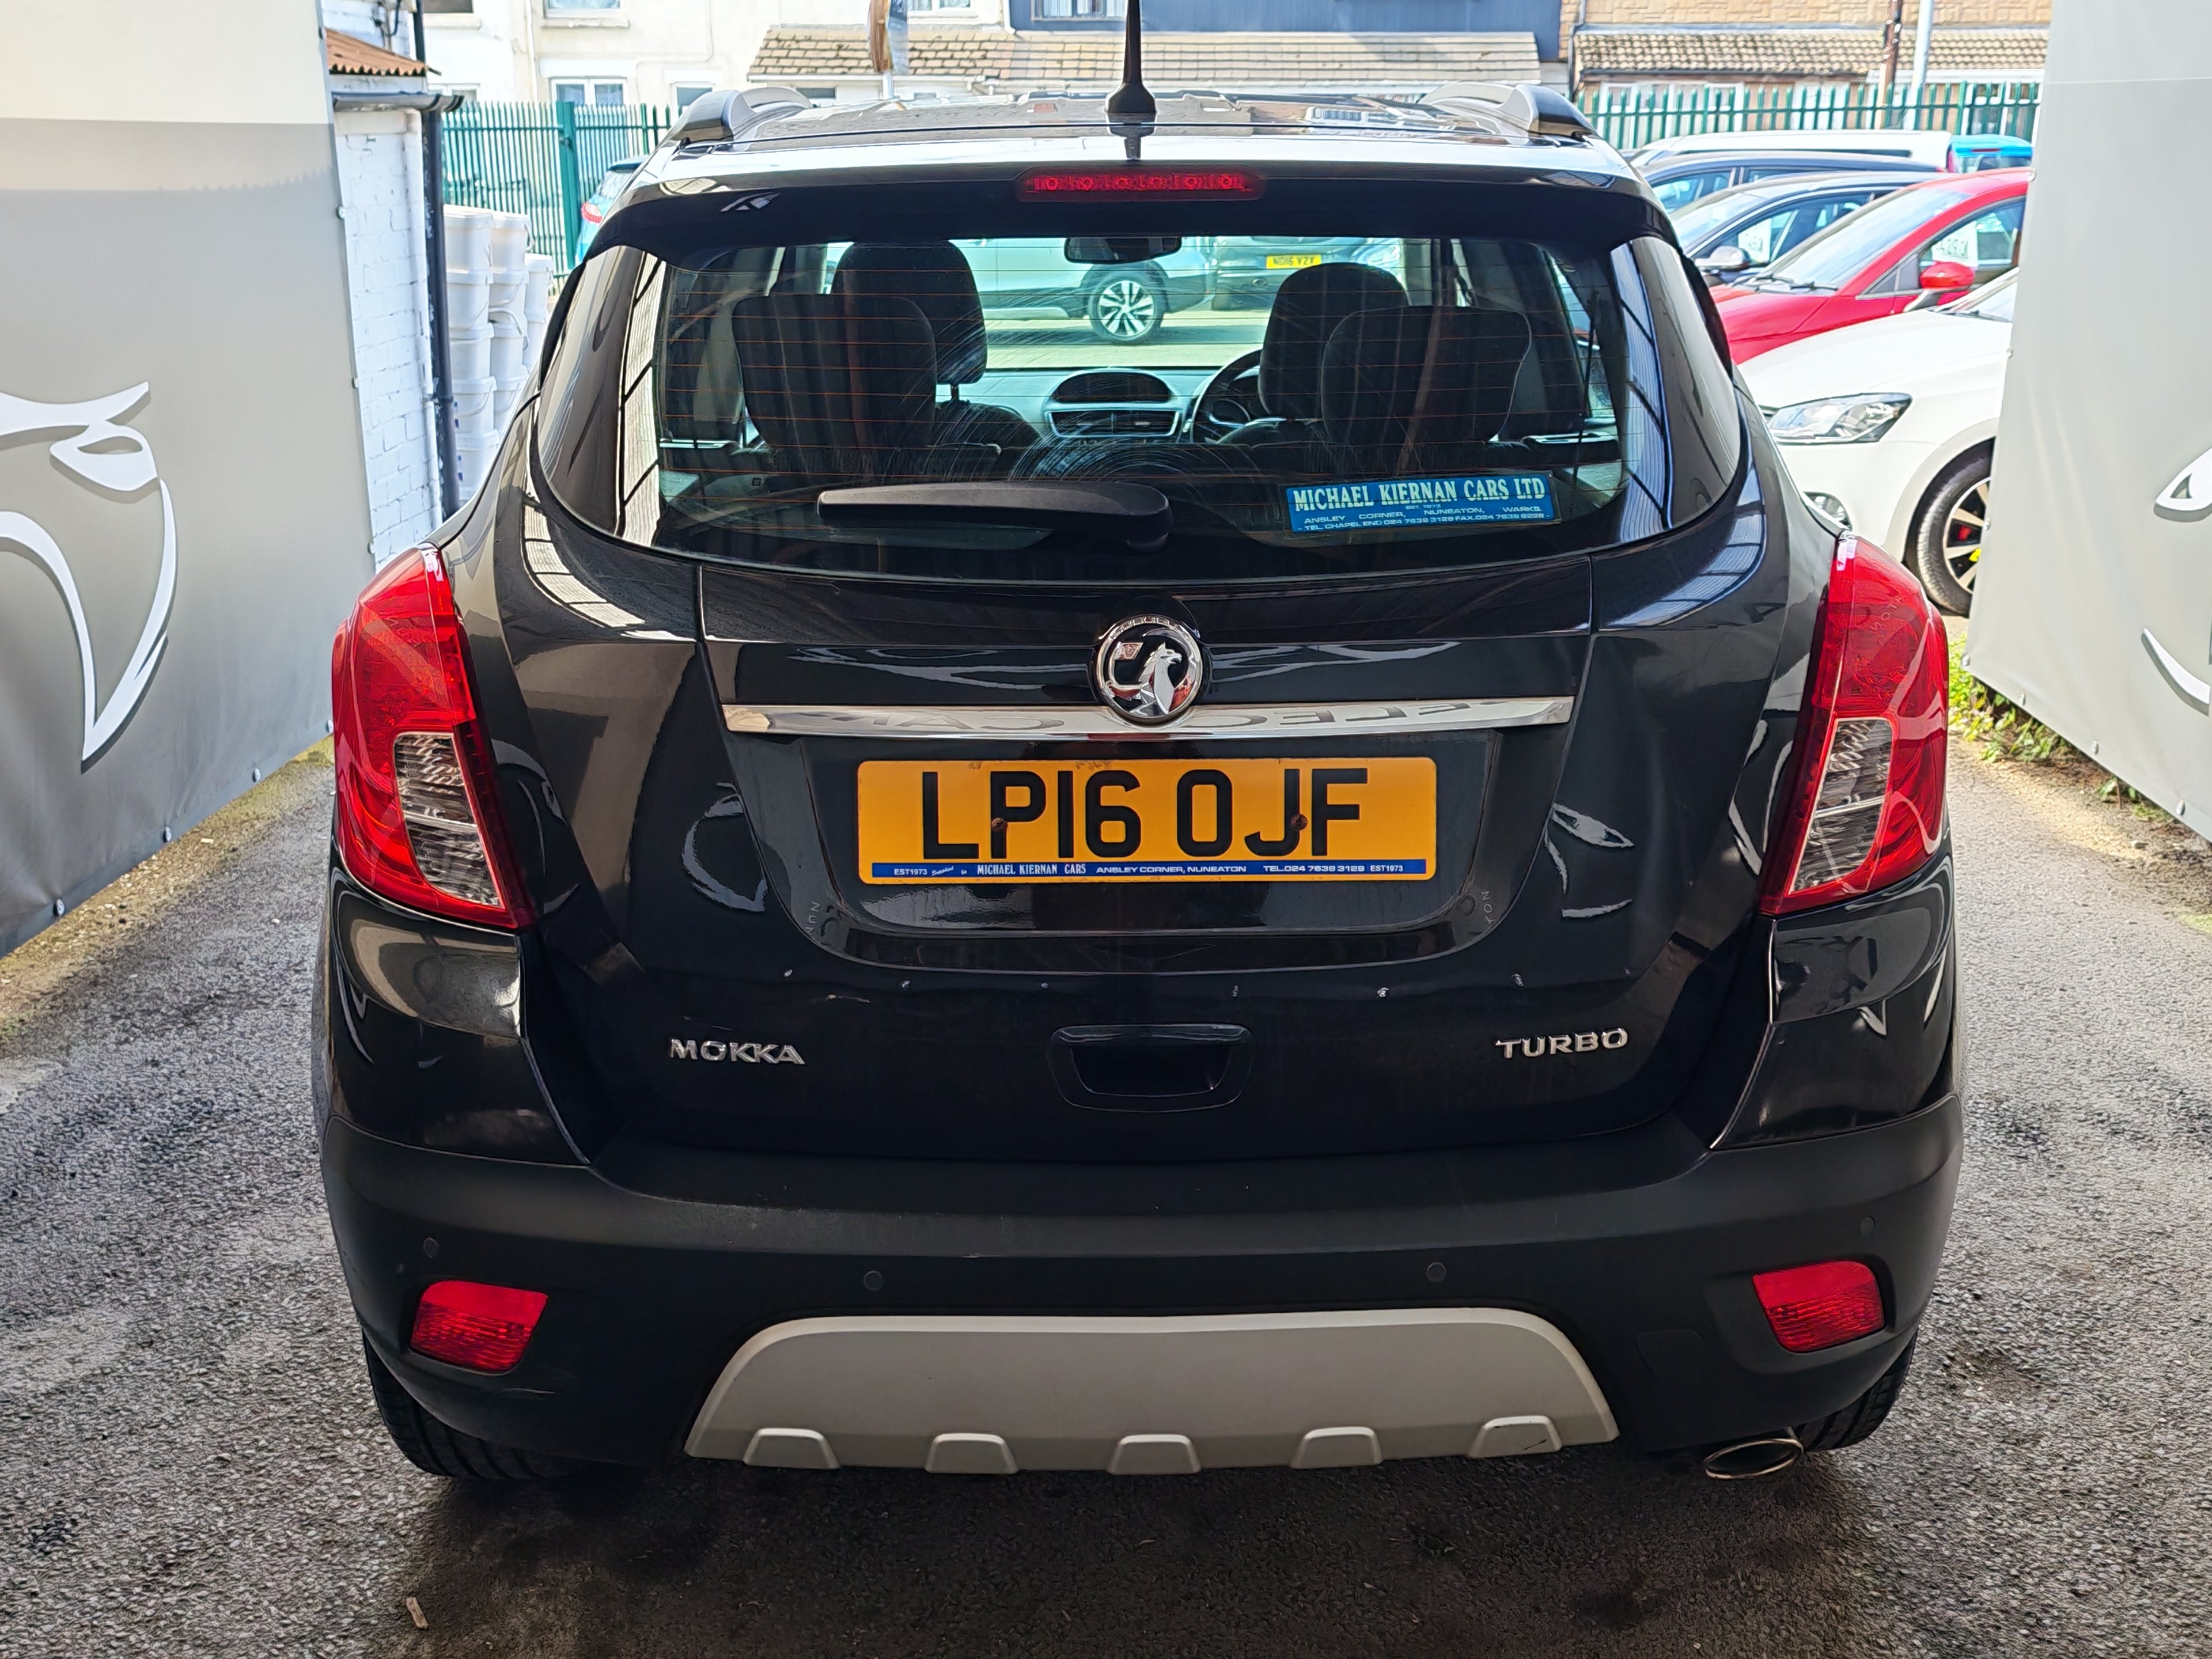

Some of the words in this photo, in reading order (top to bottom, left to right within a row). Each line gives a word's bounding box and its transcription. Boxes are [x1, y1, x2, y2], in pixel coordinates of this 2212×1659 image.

[1293, 486, 1374, 512] MICHAEL
[1378, 481, 1458, 505] KIERNAN
[1464, 478, 1509, 501] CARS
[1513, 478, 1546, 499] LTD
[1304, 516, 1346, 524] ANSLEY
[1358, 512, 1406, 520] CORNER,
[1423, 507, 1485, 515] NUNEATON,
[922, 769, 1142, 859] LP16
[1176, 768, 1368, 857] OJF
[977, 865, 1016, 875] MICHAEL
[1019, 864, 1058, 874] KIERNAN
[1064, 863, 1086, 874] CARS
[671, 1039, 805, 1065] MOKKA
[1495, 1028, 1628, 1058] TURBO
